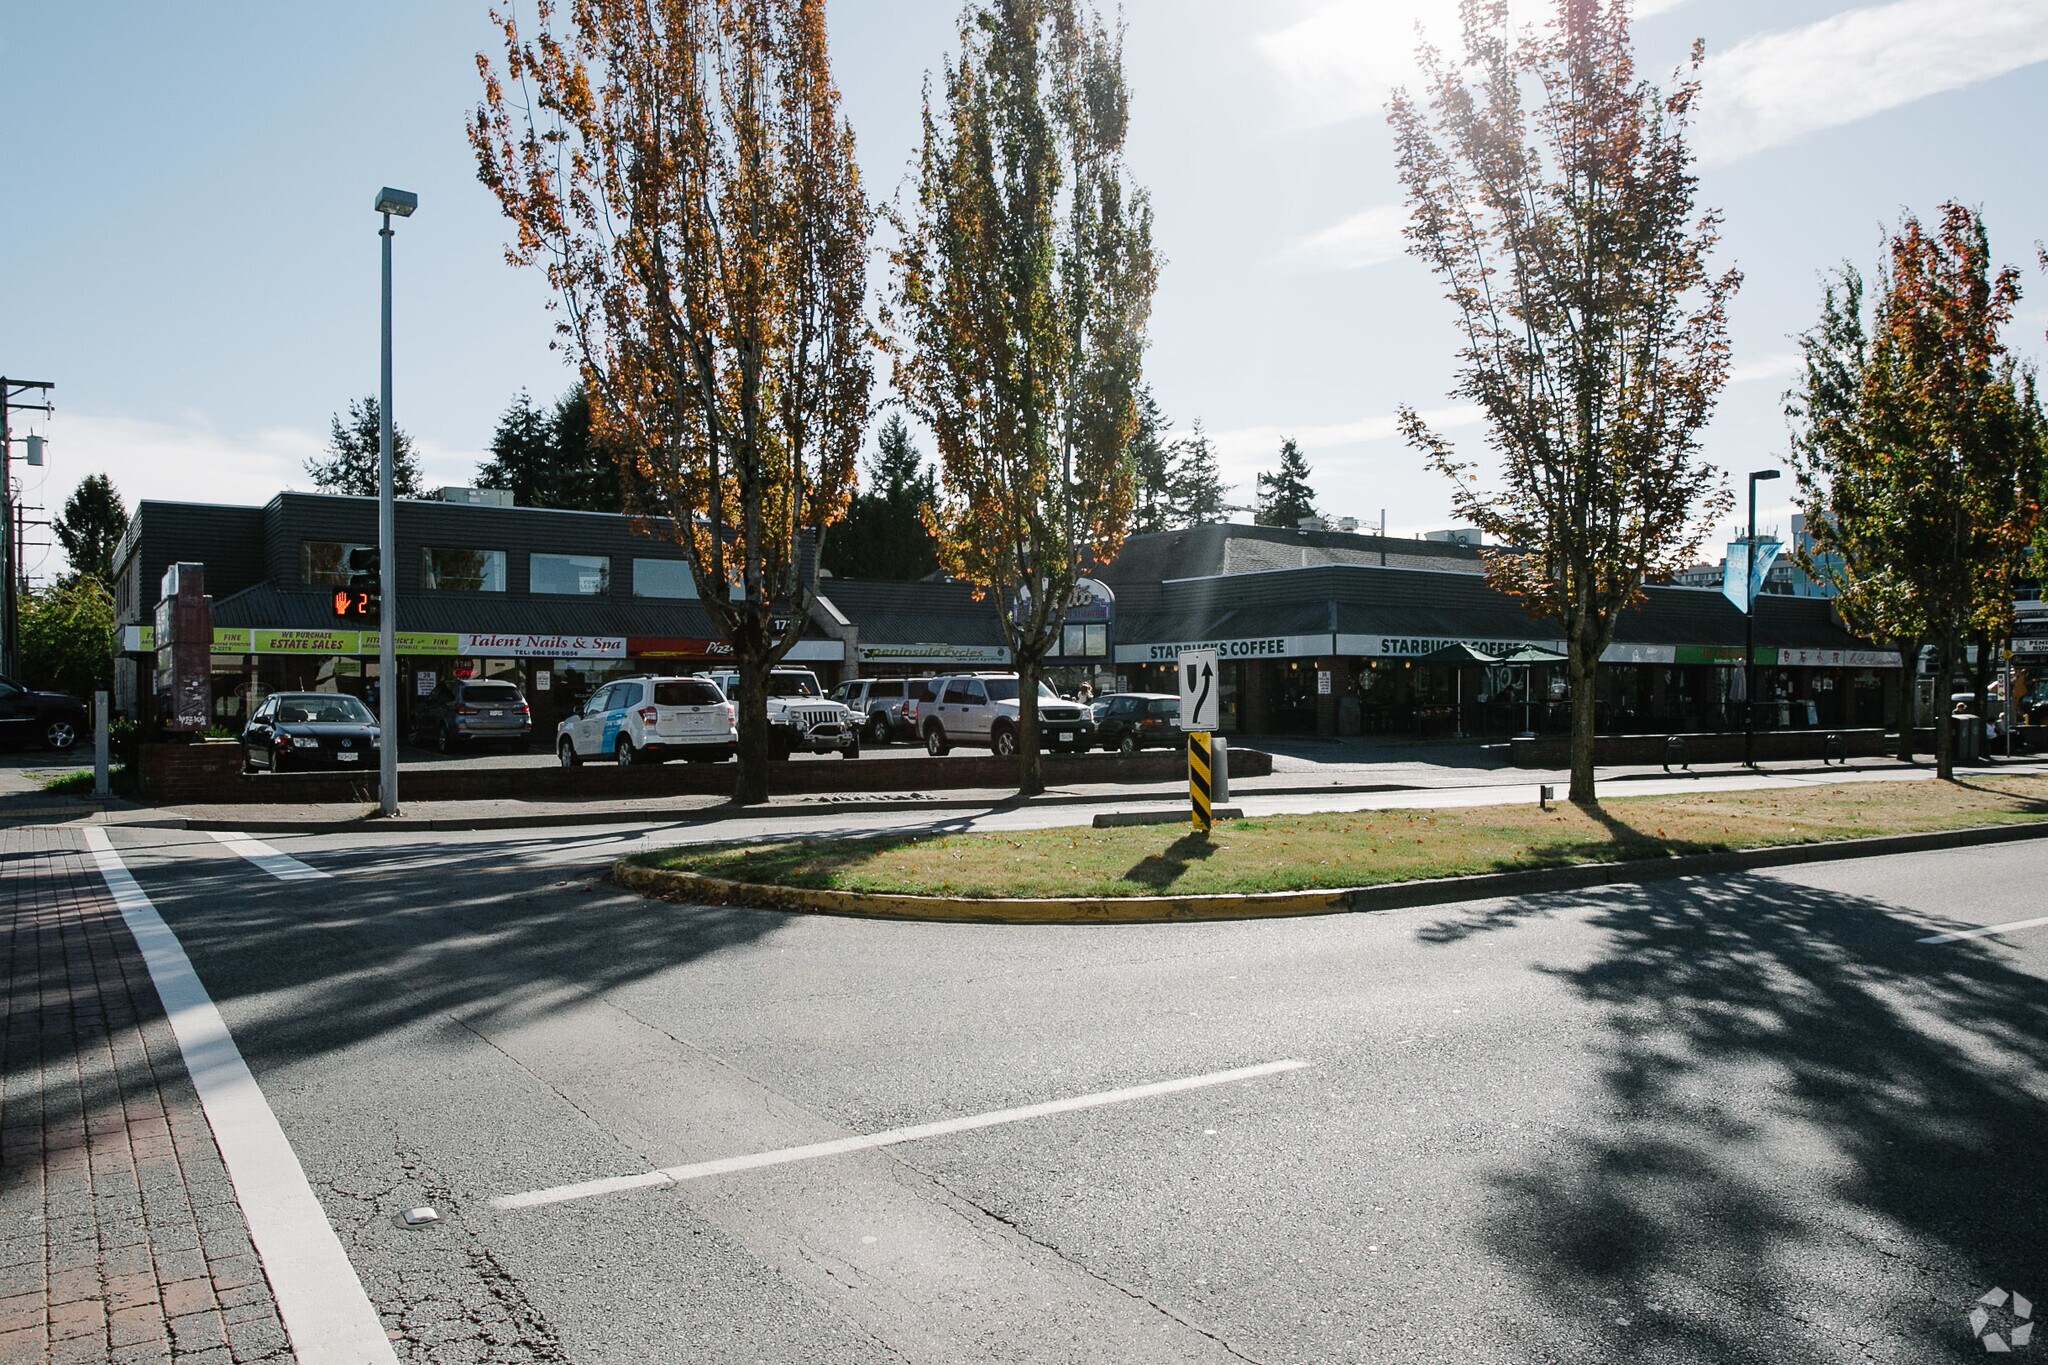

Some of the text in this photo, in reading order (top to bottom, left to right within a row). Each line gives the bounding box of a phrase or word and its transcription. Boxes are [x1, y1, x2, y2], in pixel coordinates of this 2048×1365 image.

[358, 593, 368, 614] 2
[224, 633, 242, 641] FINE
[295, 631, 333, 639] PURCHASE
[269, 639, 344, 650] ESTATE SALES
[469, 634, 621, 653] Talent Nails & Spa
[705, 641, 734, 654] Pizz
[1150, 639, 1285, 660] STARS COFFEE
[1381, 638, 1468, 654] STARBUC
[872, 647, 942, 660] peninsula
[943, 646, 984, 660] cycles
